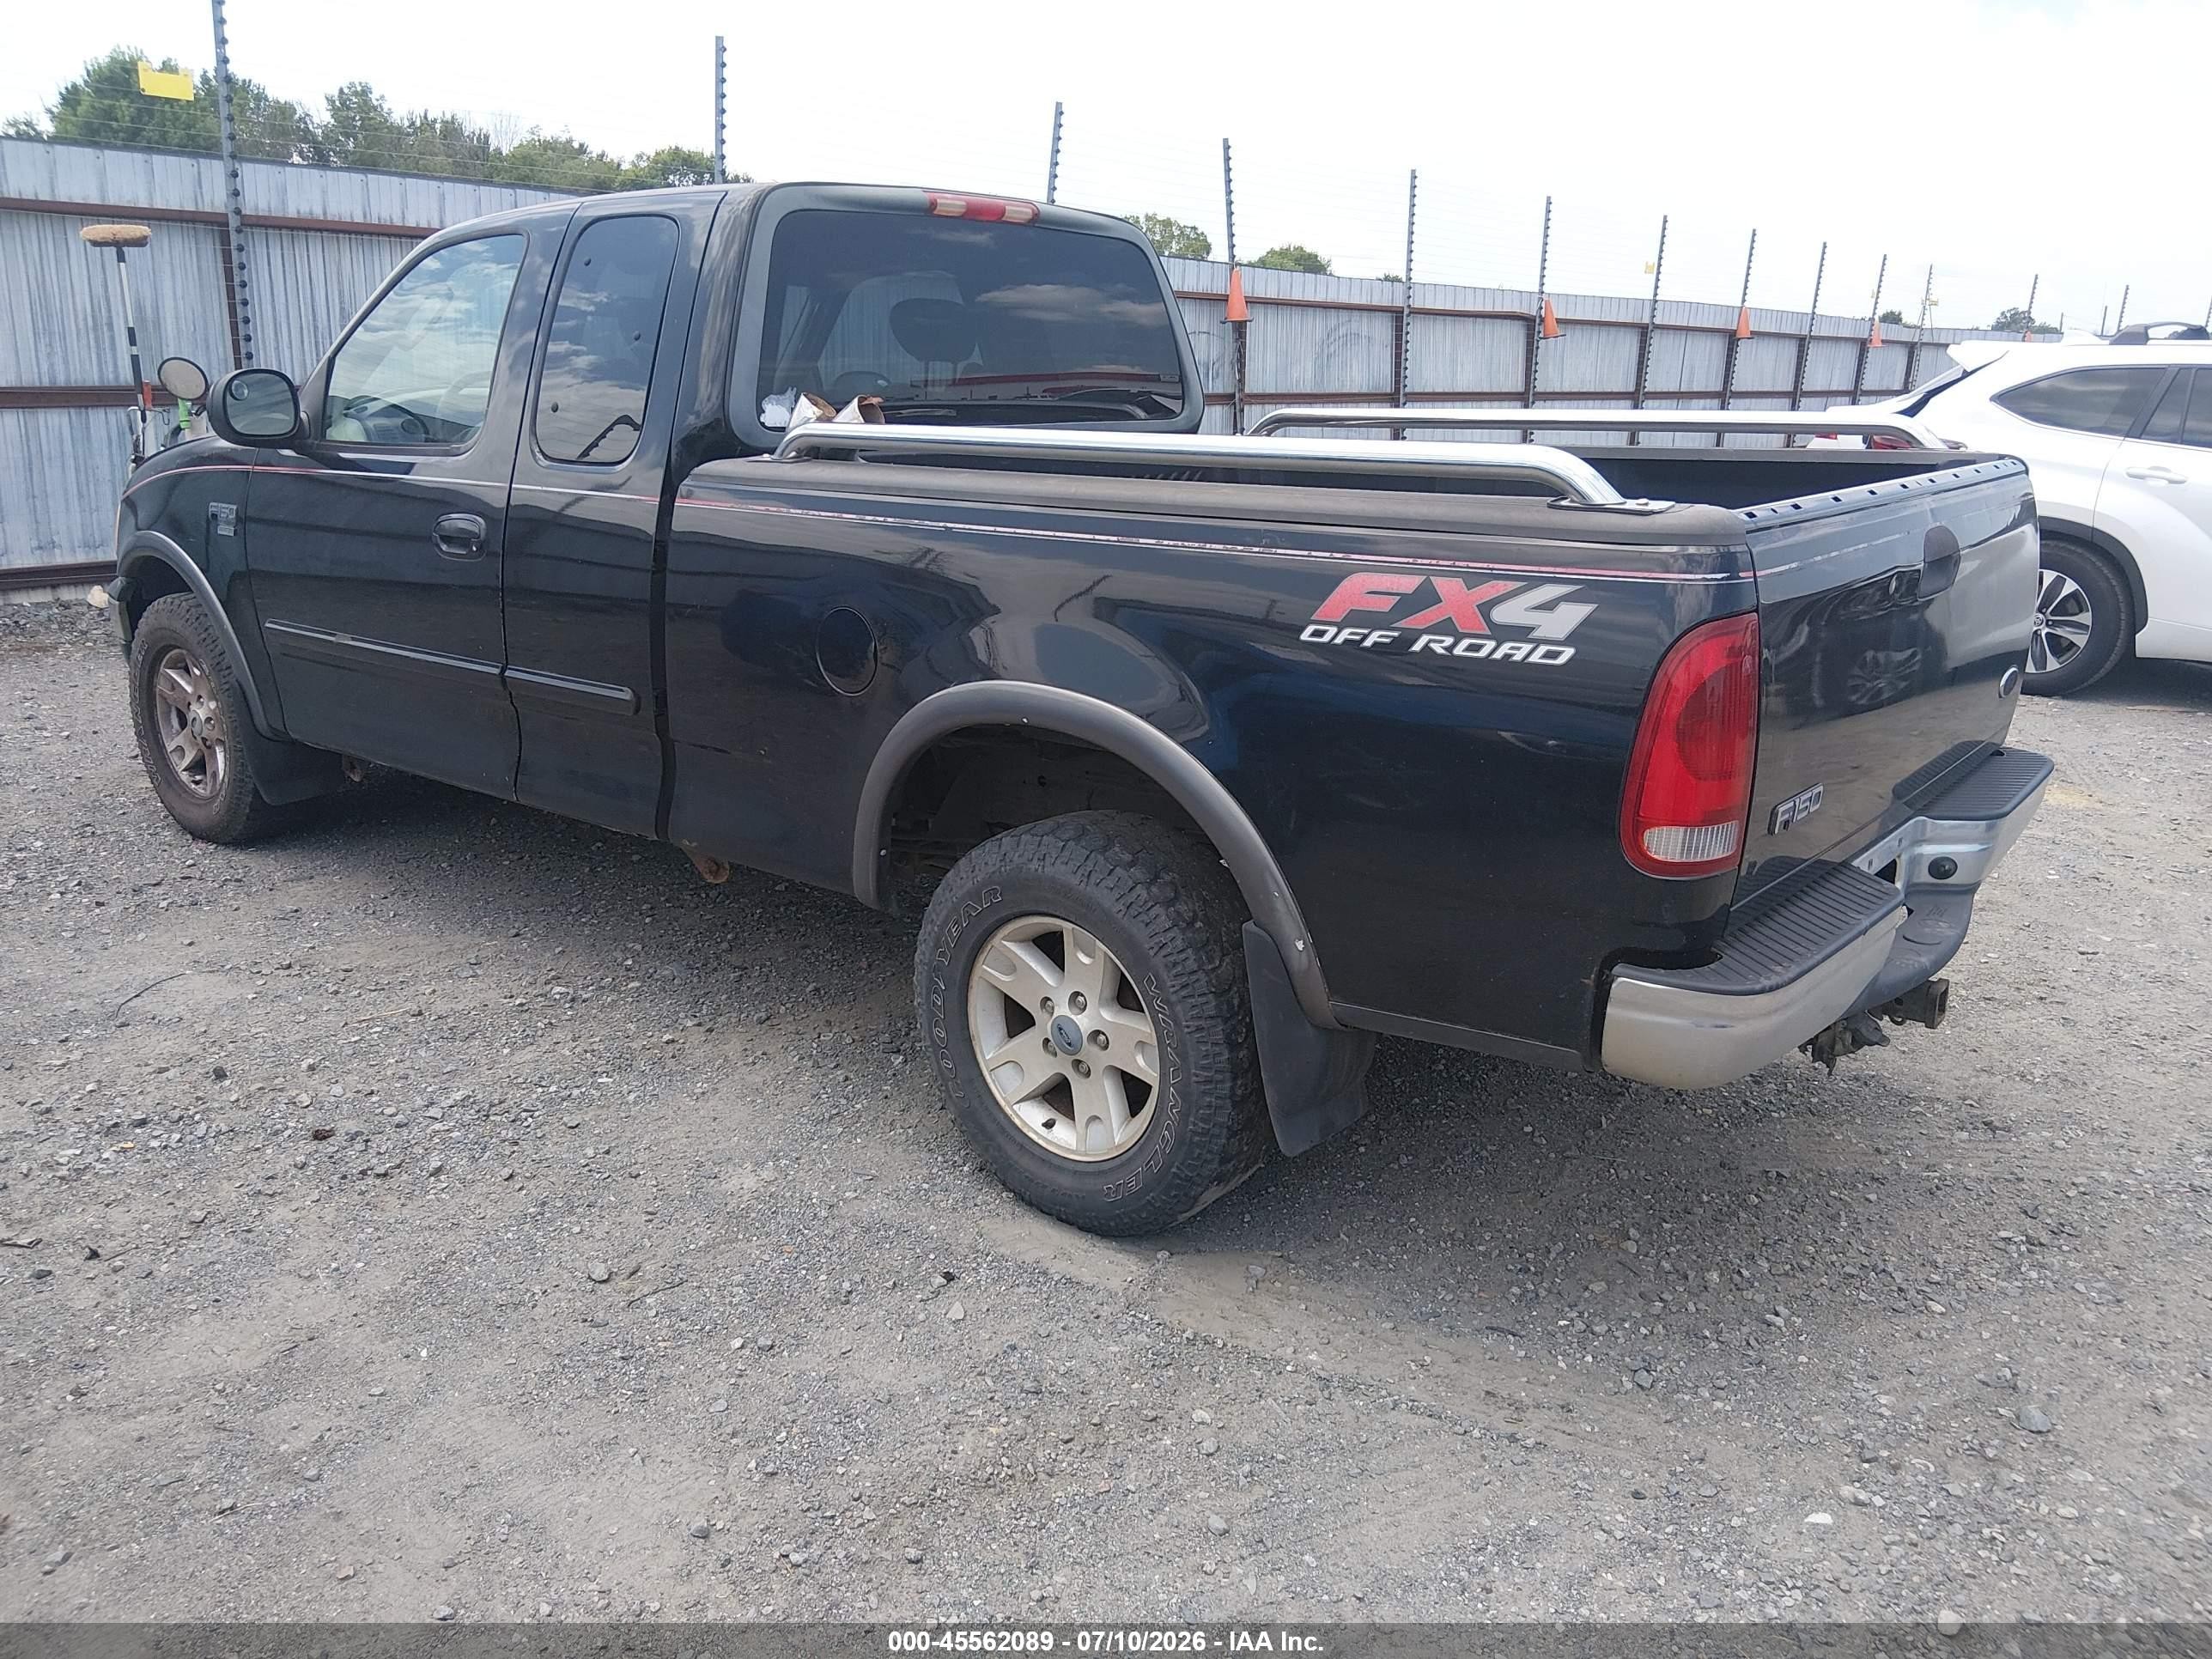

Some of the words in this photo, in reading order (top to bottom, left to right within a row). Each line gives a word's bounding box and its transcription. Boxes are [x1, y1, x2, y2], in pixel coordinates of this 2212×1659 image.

[1310, 572, 1599, 641] FX4
[1299, 624, 1402, 648] OFF
[1408, 634, 1577, 666] ROAD
[1103, 972, 1182, 1202] WRANGLER
